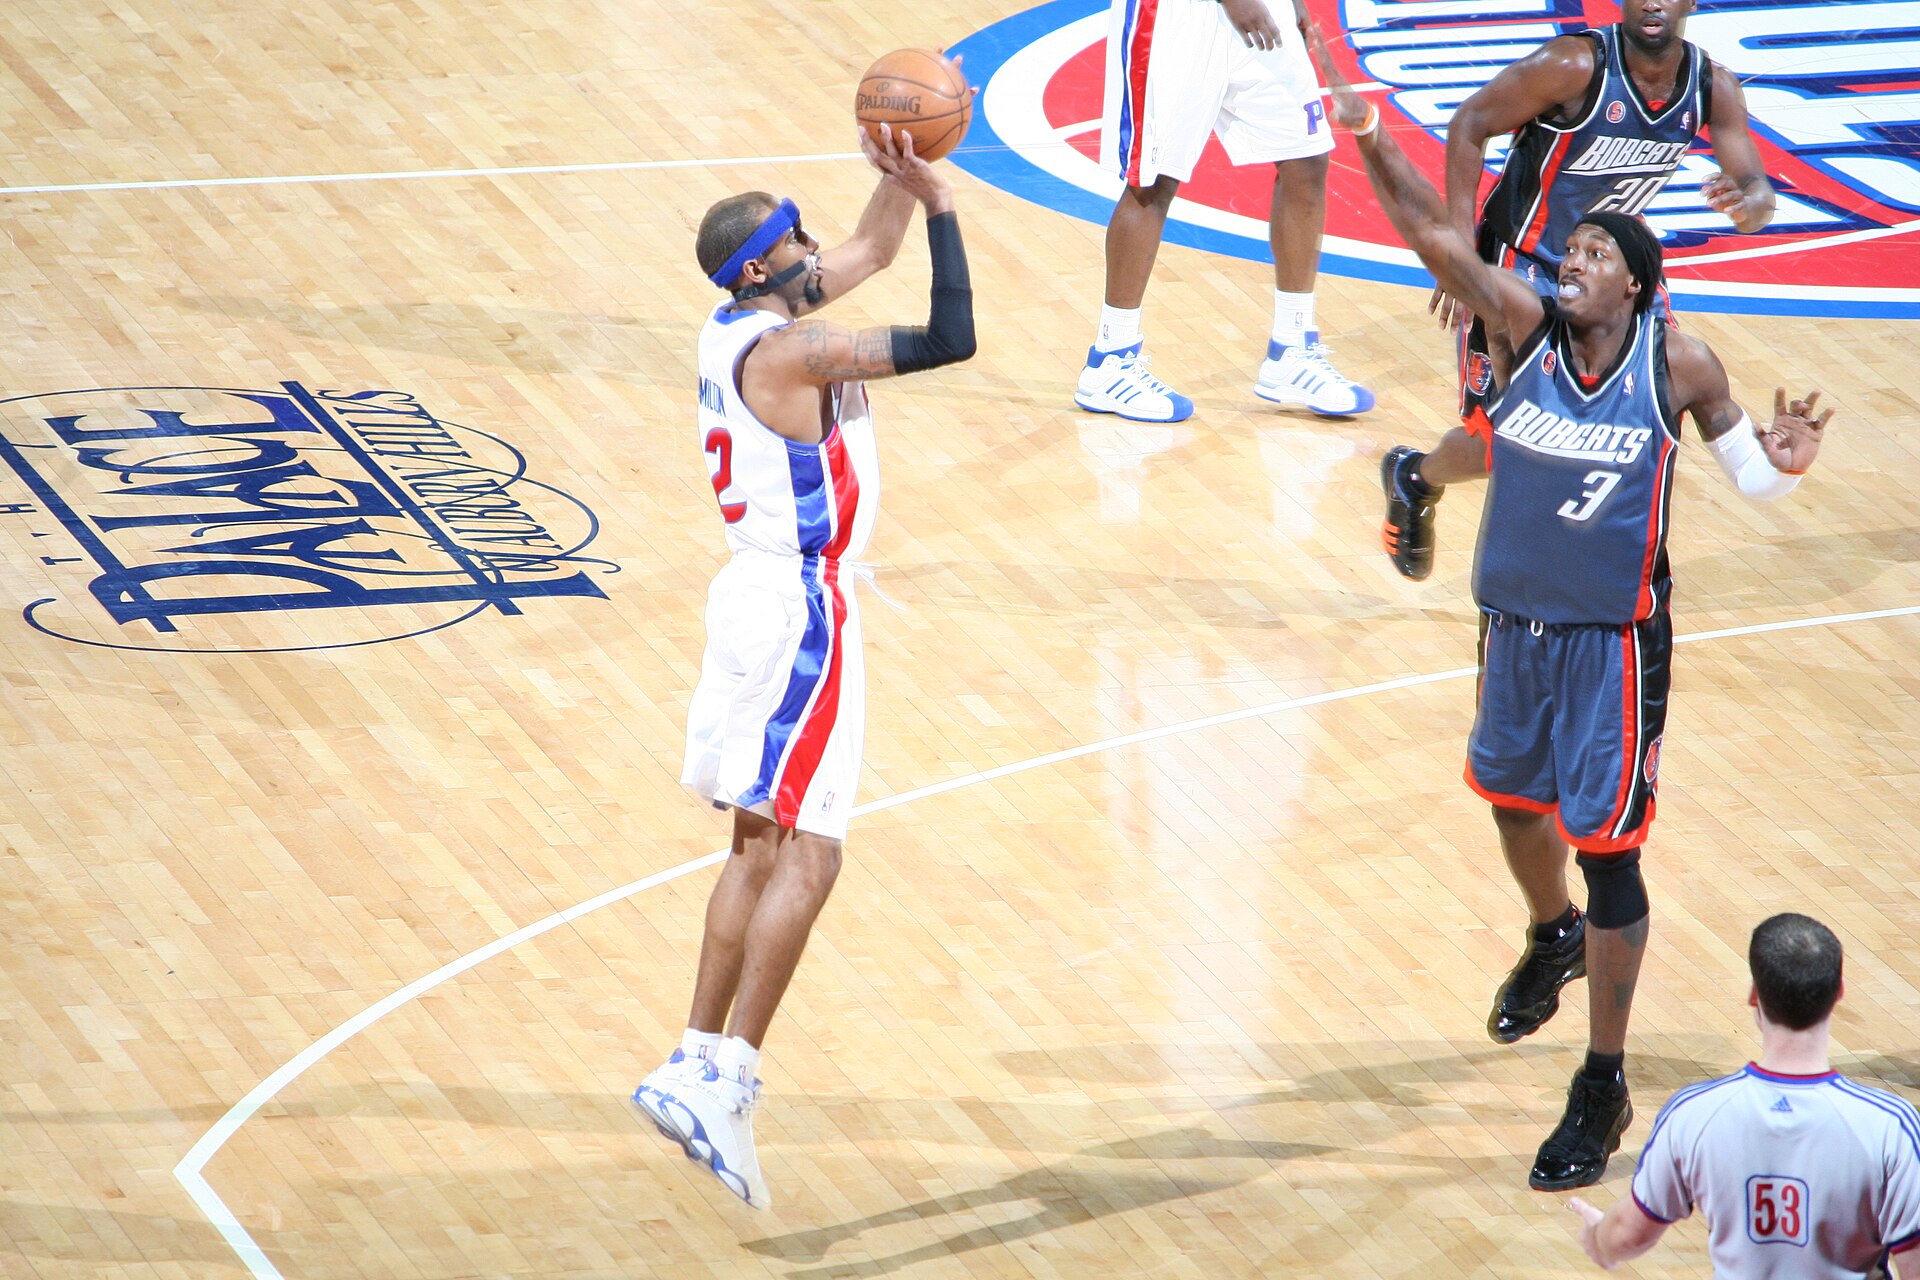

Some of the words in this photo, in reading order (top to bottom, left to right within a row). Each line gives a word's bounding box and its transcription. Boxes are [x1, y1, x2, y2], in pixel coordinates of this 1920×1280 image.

[1303, 99, 1323, 135] P
[1568, 136, 1692, 170] BOBCATS
[1587, 176, 1669, 216] 20
[316, 389, 472, 458] HILLS
[1498, 400, 1652, 464] BOBCATS
[44, 392, 610, 625] PALACE
[390, 464, 564, 551] AUBURN
[1557, 470, 1622, 521] 3
[1755, 1184, 1800, 1237] 53
